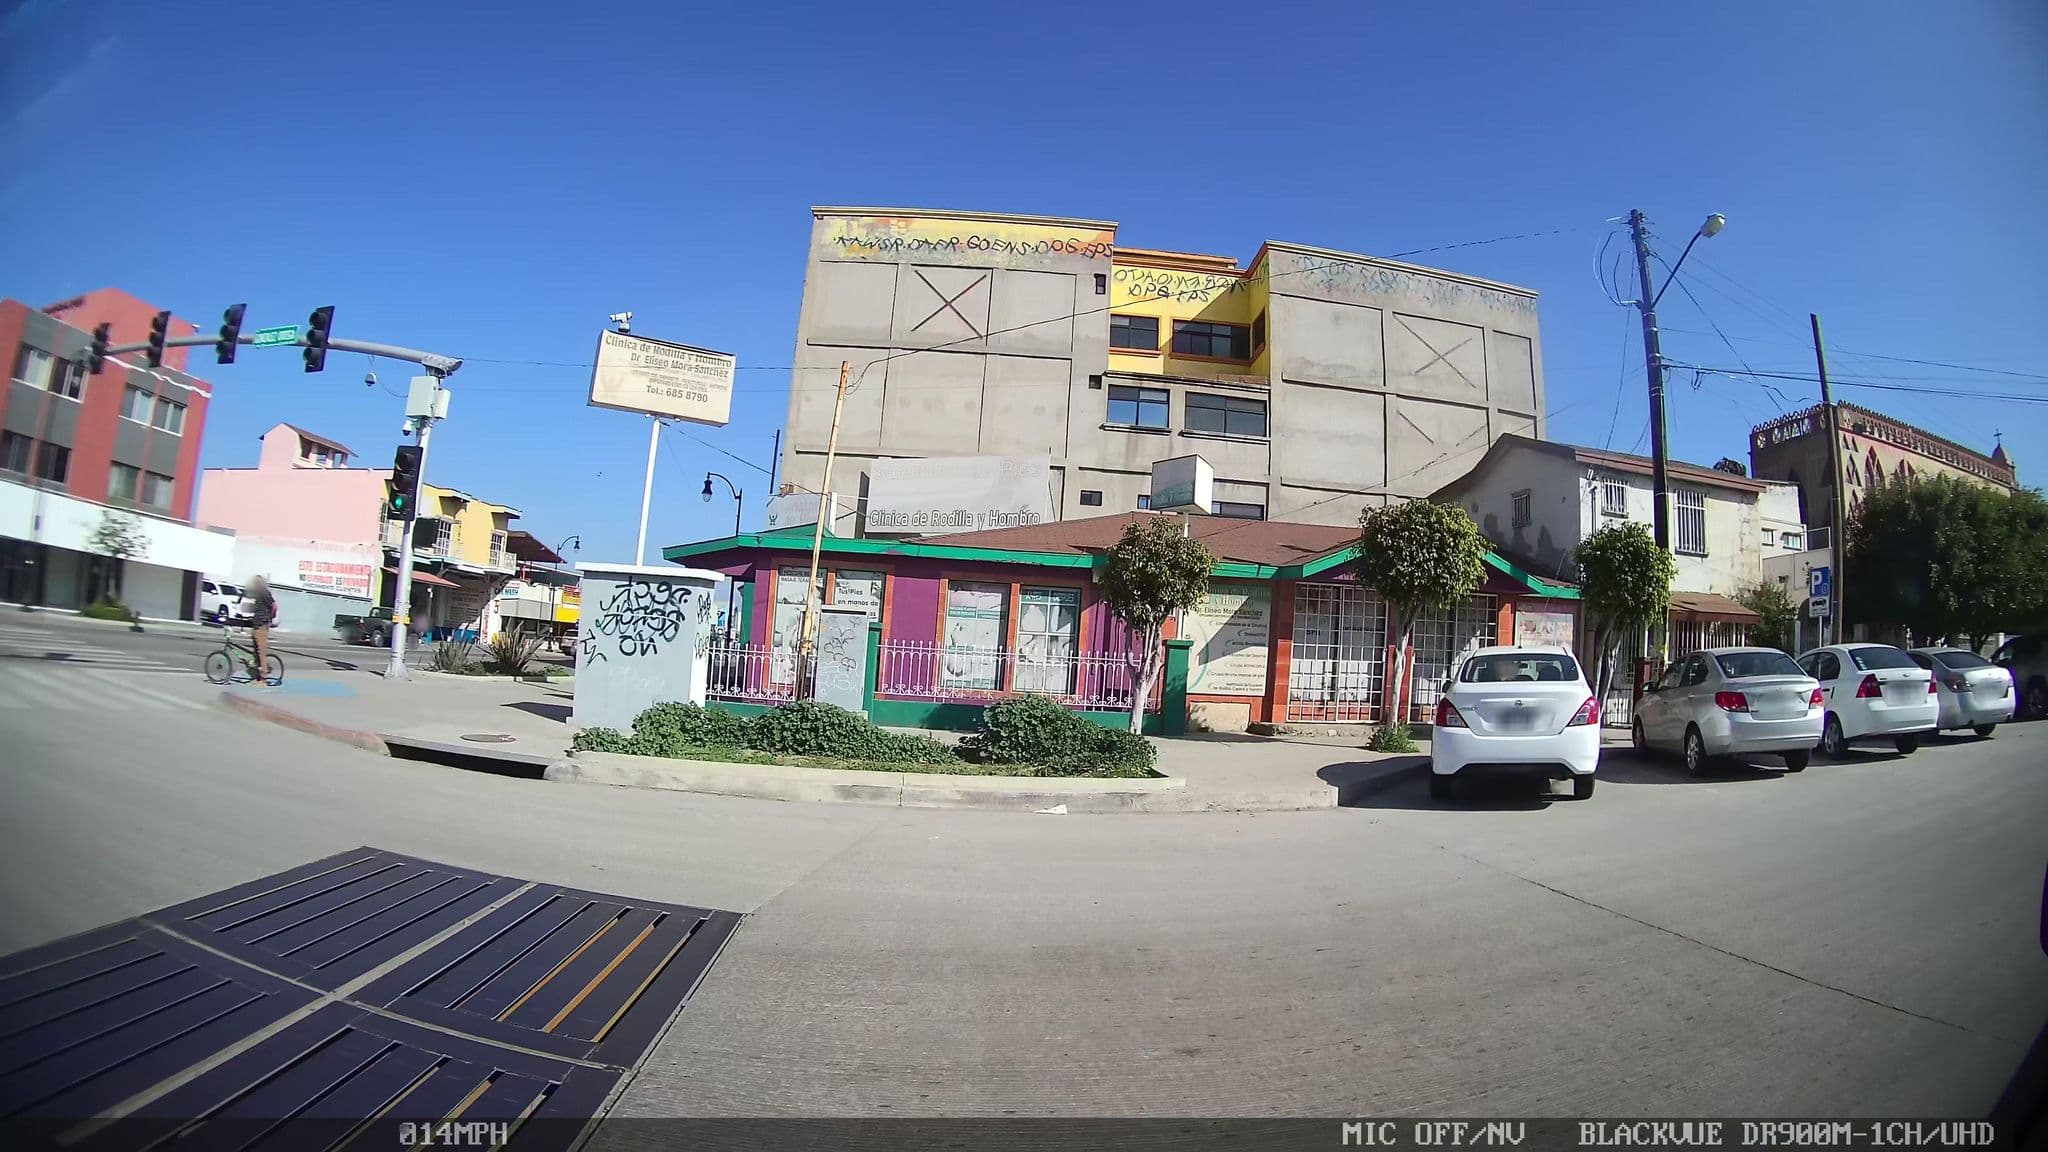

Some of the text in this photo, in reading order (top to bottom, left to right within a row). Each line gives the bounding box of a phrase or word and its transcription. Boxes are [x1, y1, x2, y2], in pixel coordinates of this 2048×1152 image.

[640, 342, 652, 353] de
[645, 355, 669, 367] Eliseo
[671, 359, 692, 372] Mora
[666, 387, 683, 399] 685
[685, 390, 709, 403] 8790
[912, 510, 928, 527] de
[931, 510, 973, 527] Rodilla
[977, 512, 985, 531] y
[988, 509, 1041, 527] Hombro
[1811, 571, 1822, 594] P
